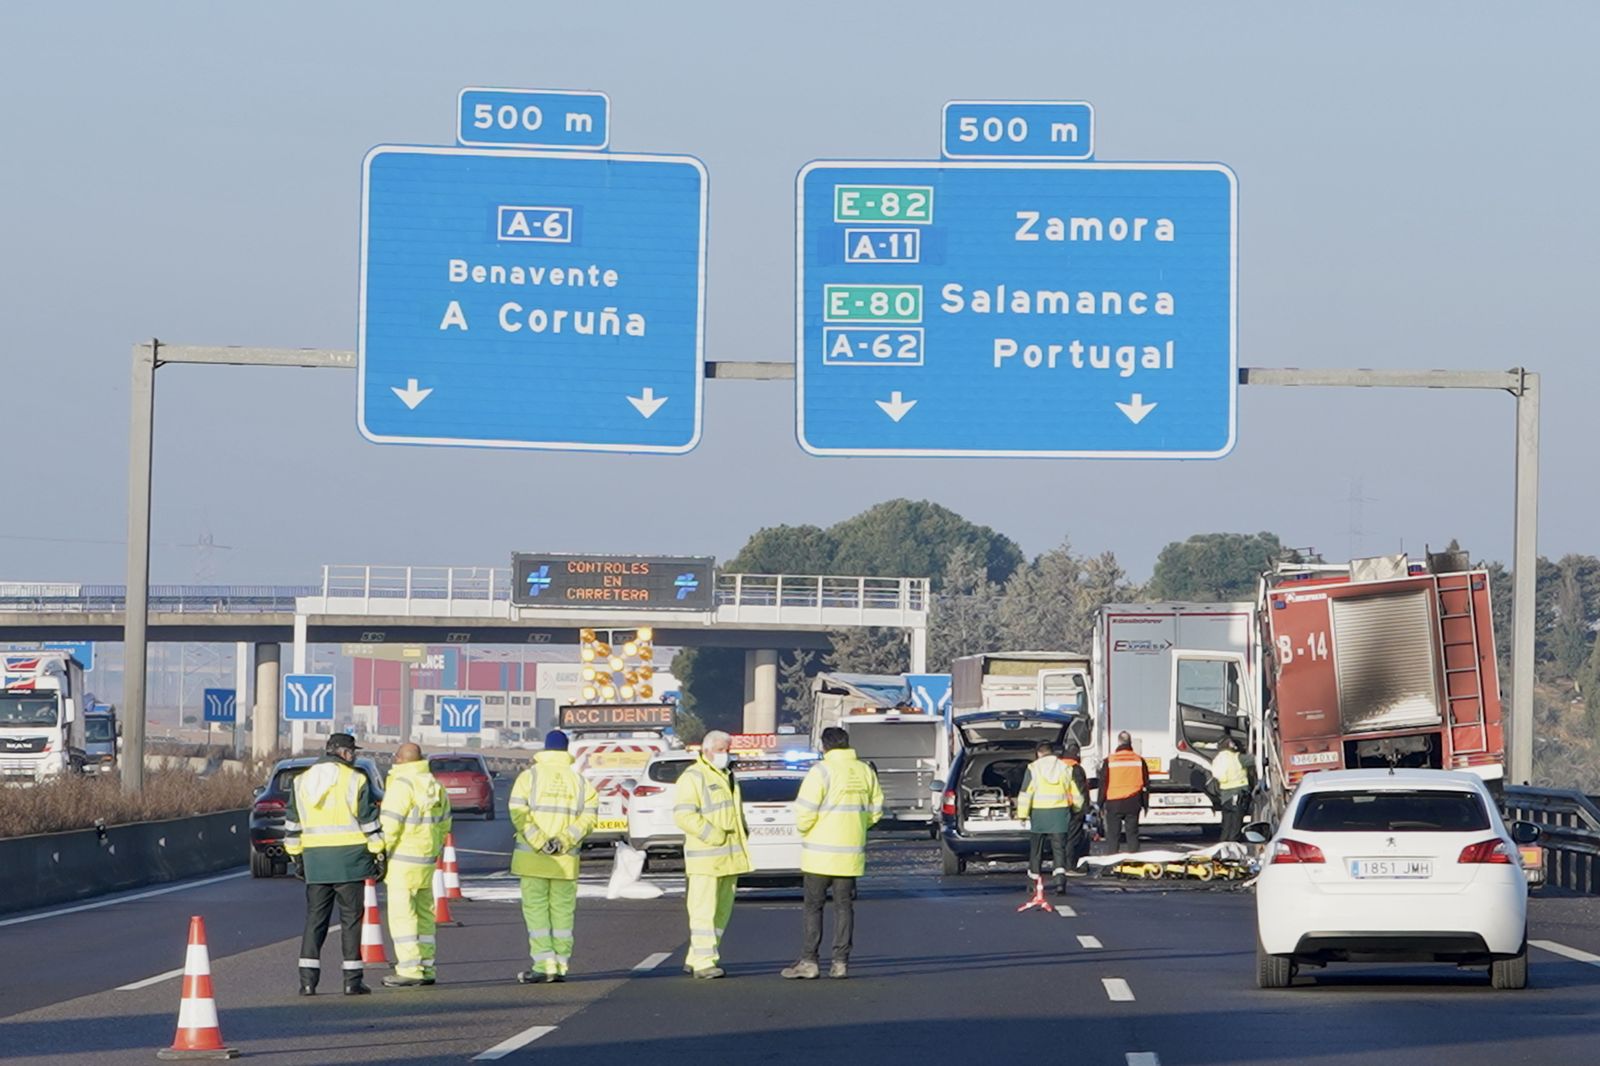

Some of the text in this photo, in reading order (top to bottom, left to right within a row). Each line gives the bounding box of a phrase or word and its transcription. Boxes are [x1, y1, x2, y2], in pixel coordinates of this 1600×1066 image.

[473, 104, 593, 132] 500 m
[959, 117, 1078, 142] 500 m
[841, 192, 926, 217] E-82
[507, 212, 563, 238] A-6
[1015, 211, 1175, 242] Zamora
[852, 234, 914, 259] A-11
[449, 259, 619, 287] Benavente
[830, 291, 916, 316] E-80
[940, 283, 1175, 316] Salamanca
[439, 301, 645, 337] A Coruña
[830, 333, 918, 359] A-62
[993, 338, 1175, 377] Portugal
[567, 561, 649, 575] CONTROLES
[603, 575, 622, 587] EN
[566, 588, 649, 601] CARRETERA
[564, 707, 671, 724] ACCIDENTE
[1364, 862, 1429, 874] 1851 JMH
